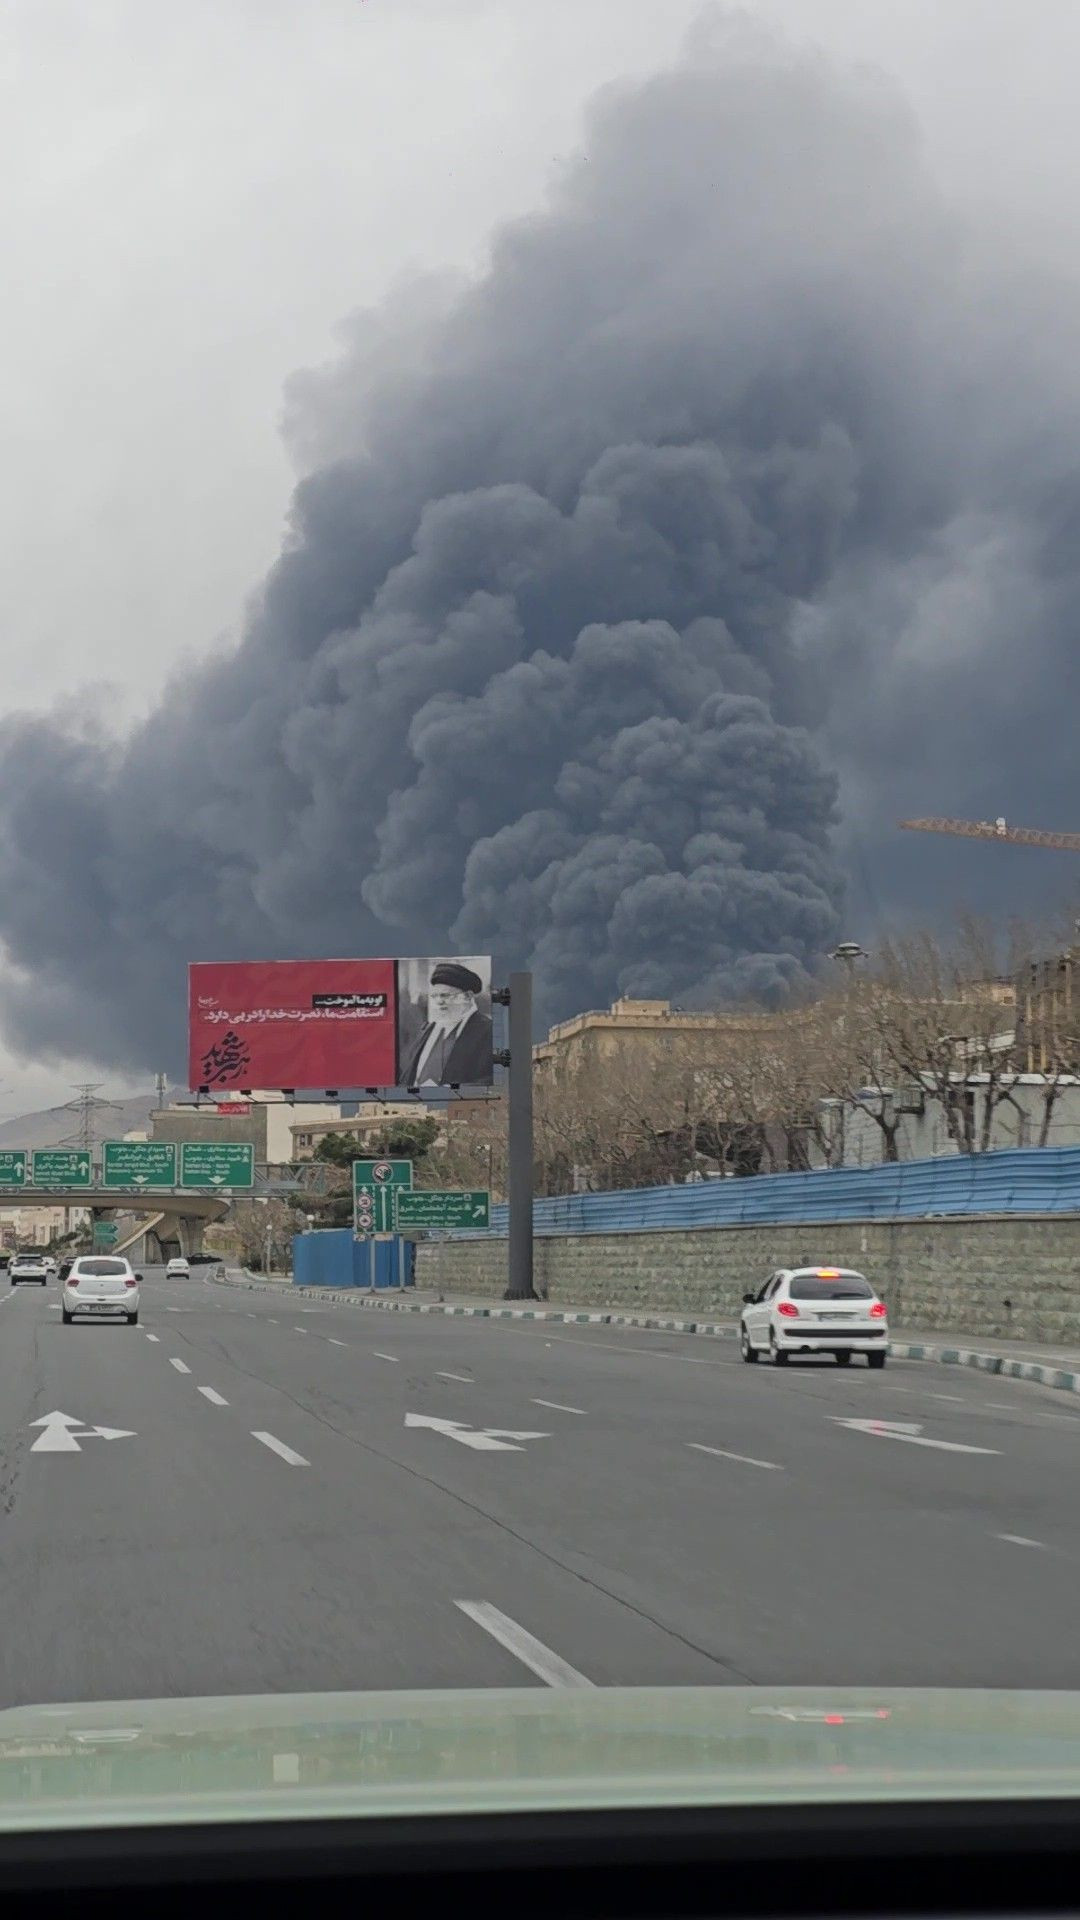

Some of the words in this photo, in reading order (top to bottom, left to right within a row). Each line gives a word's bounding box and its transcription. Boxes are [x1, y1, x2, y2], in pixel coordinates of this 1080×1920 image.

[228, 1012, 245, 1024] پی
[245, 1010, 258, 1022] در
[258, 1009, 267, 1022] را
[267, 1009, 288, 1020] خدا
[288, 1008, 321, 1022] نصرت
[336, 1007, 384, 1019] استقامت
